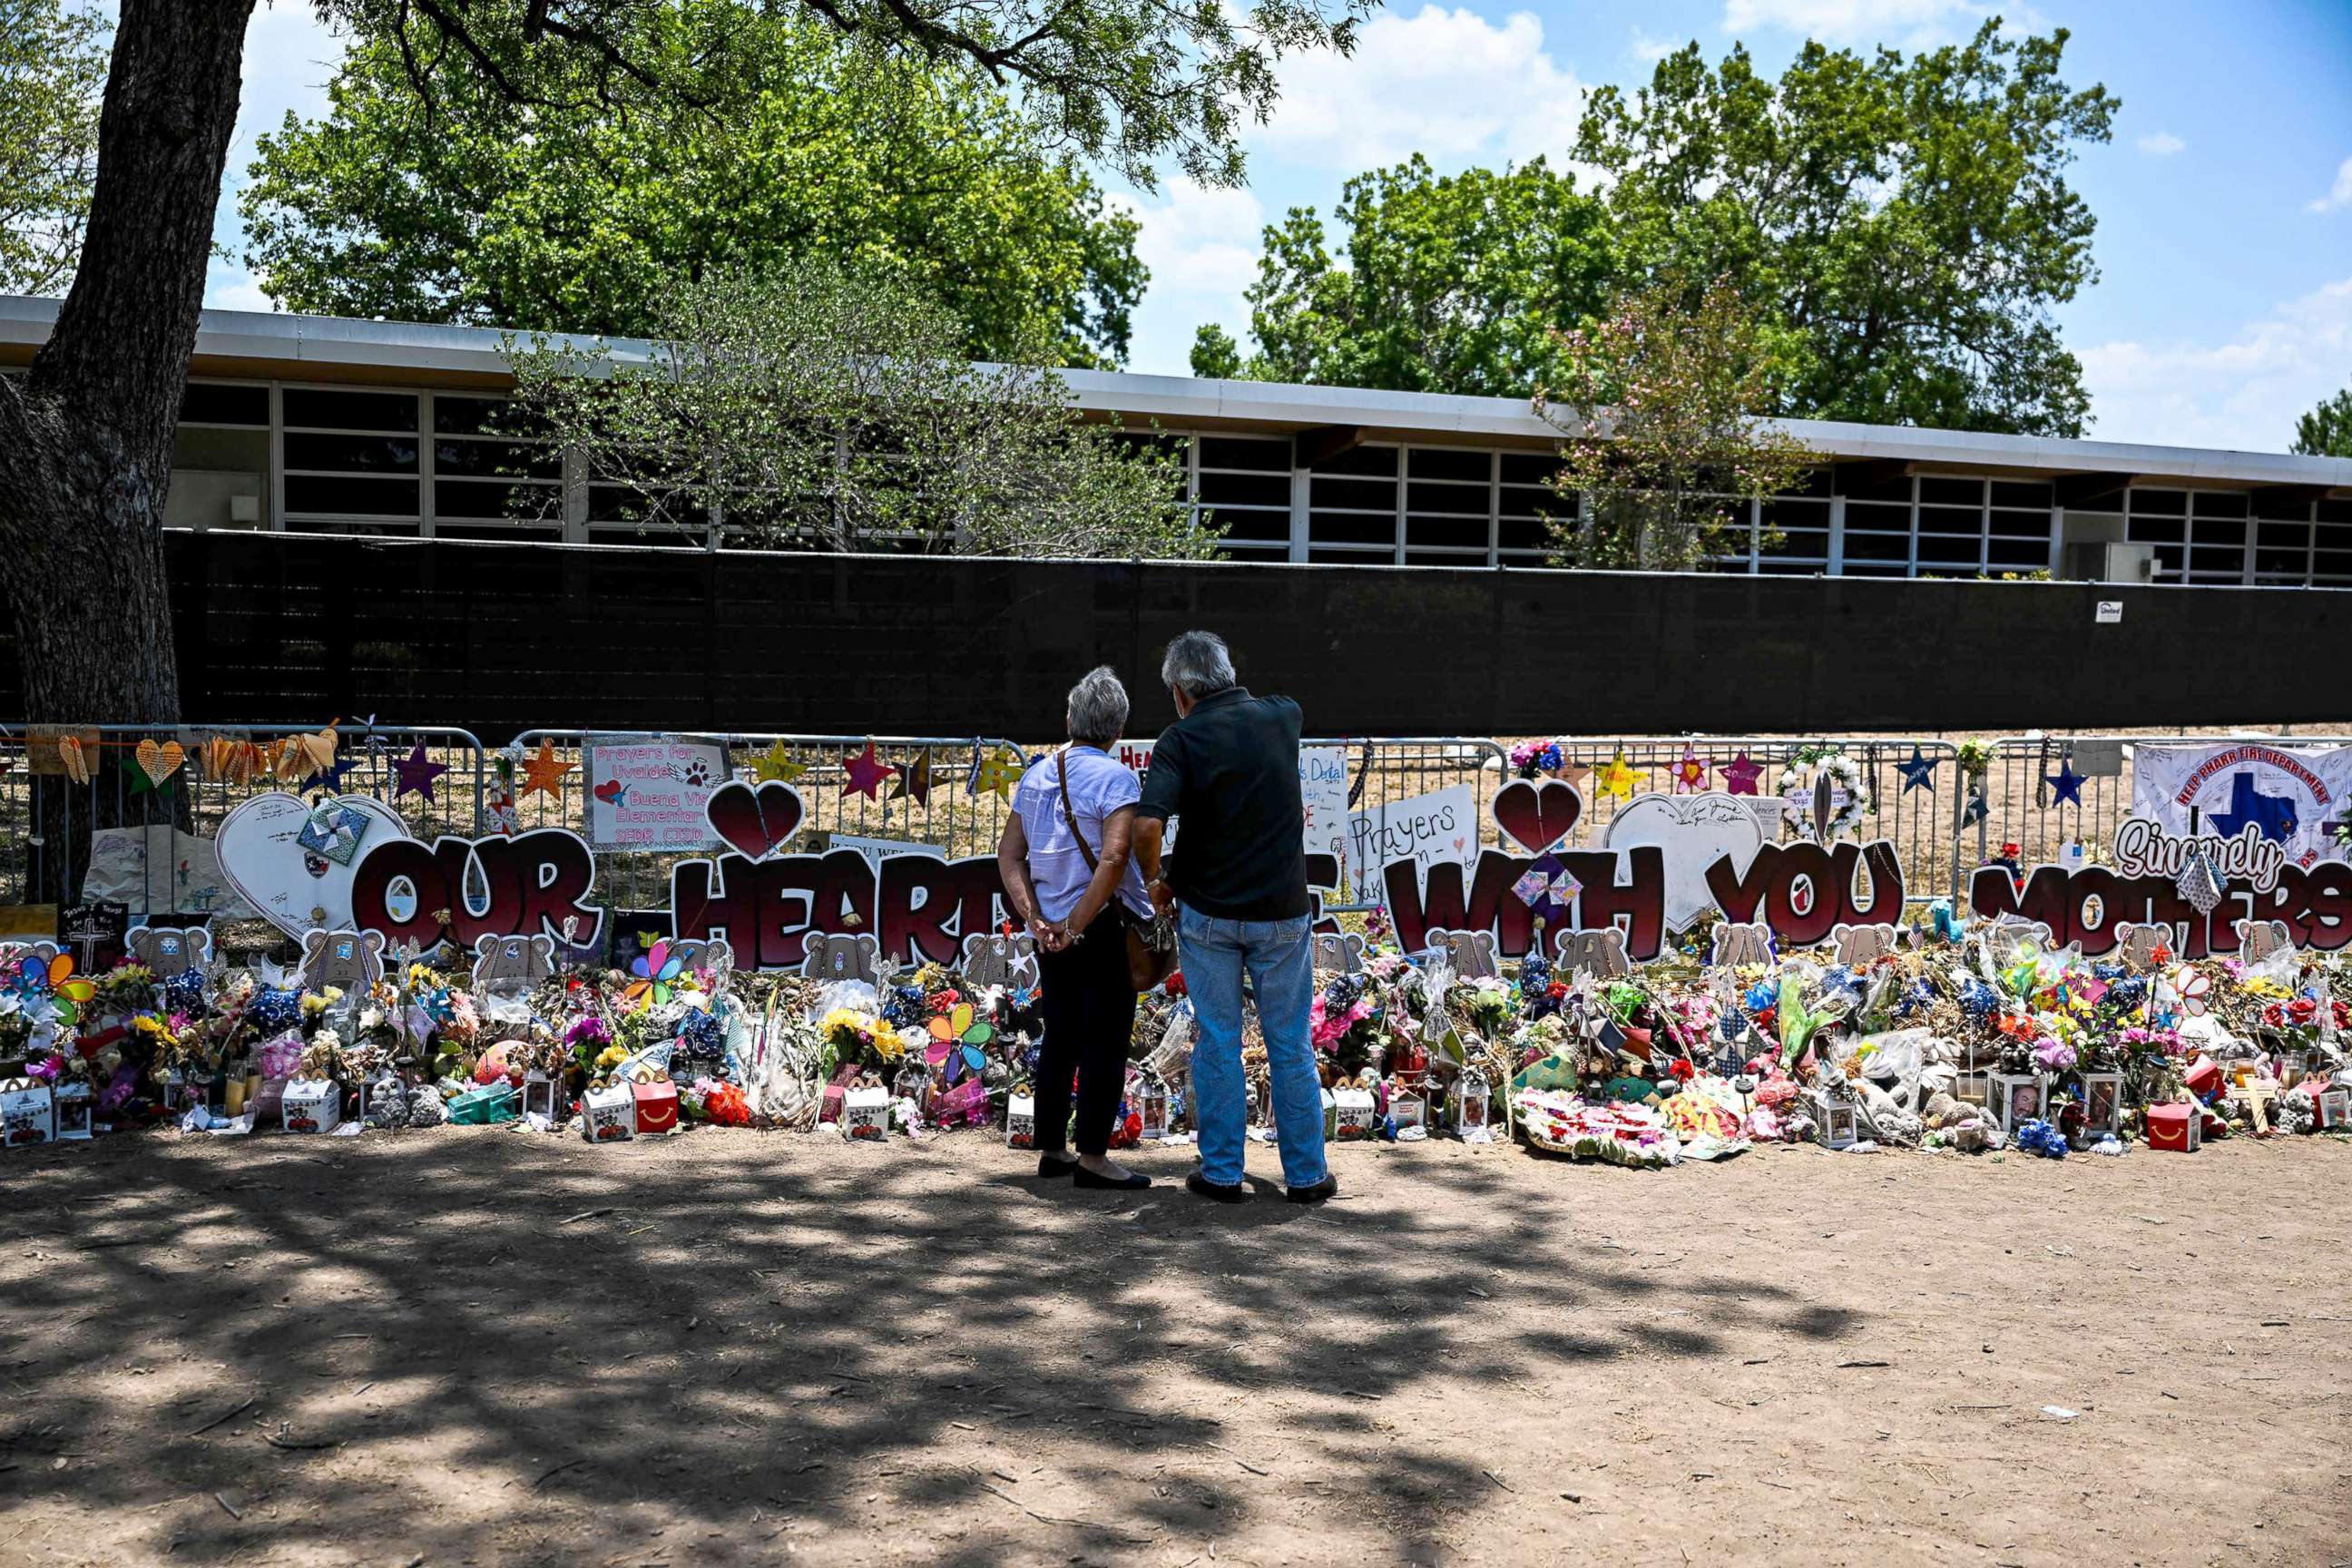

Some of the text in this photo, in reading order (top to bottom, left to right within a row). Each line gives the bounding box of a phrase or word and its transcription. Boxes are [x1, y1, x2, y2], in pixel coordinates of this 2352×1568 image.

[595, 744, 696, 762] Prayers for
[612, 764, 669, 779] Uvalde
[2175, 773, 2202, 807] HELP
[2197, 750, 2238, 781] PHARR
[2238, 746, 2265, 760] FIRE
[2264, 749, 2332, 806] DEPARTMENT
[630, 791, 707, 807] Buena Vis
[615, 828, 703, 843] SFDR CISD
[1351, 805, 1455, 857] Prayers
[352, 828, 603, 956] OUR
[672, 848, 1028, 971] HEART
[1703, 838, 1906, 947] YOU
